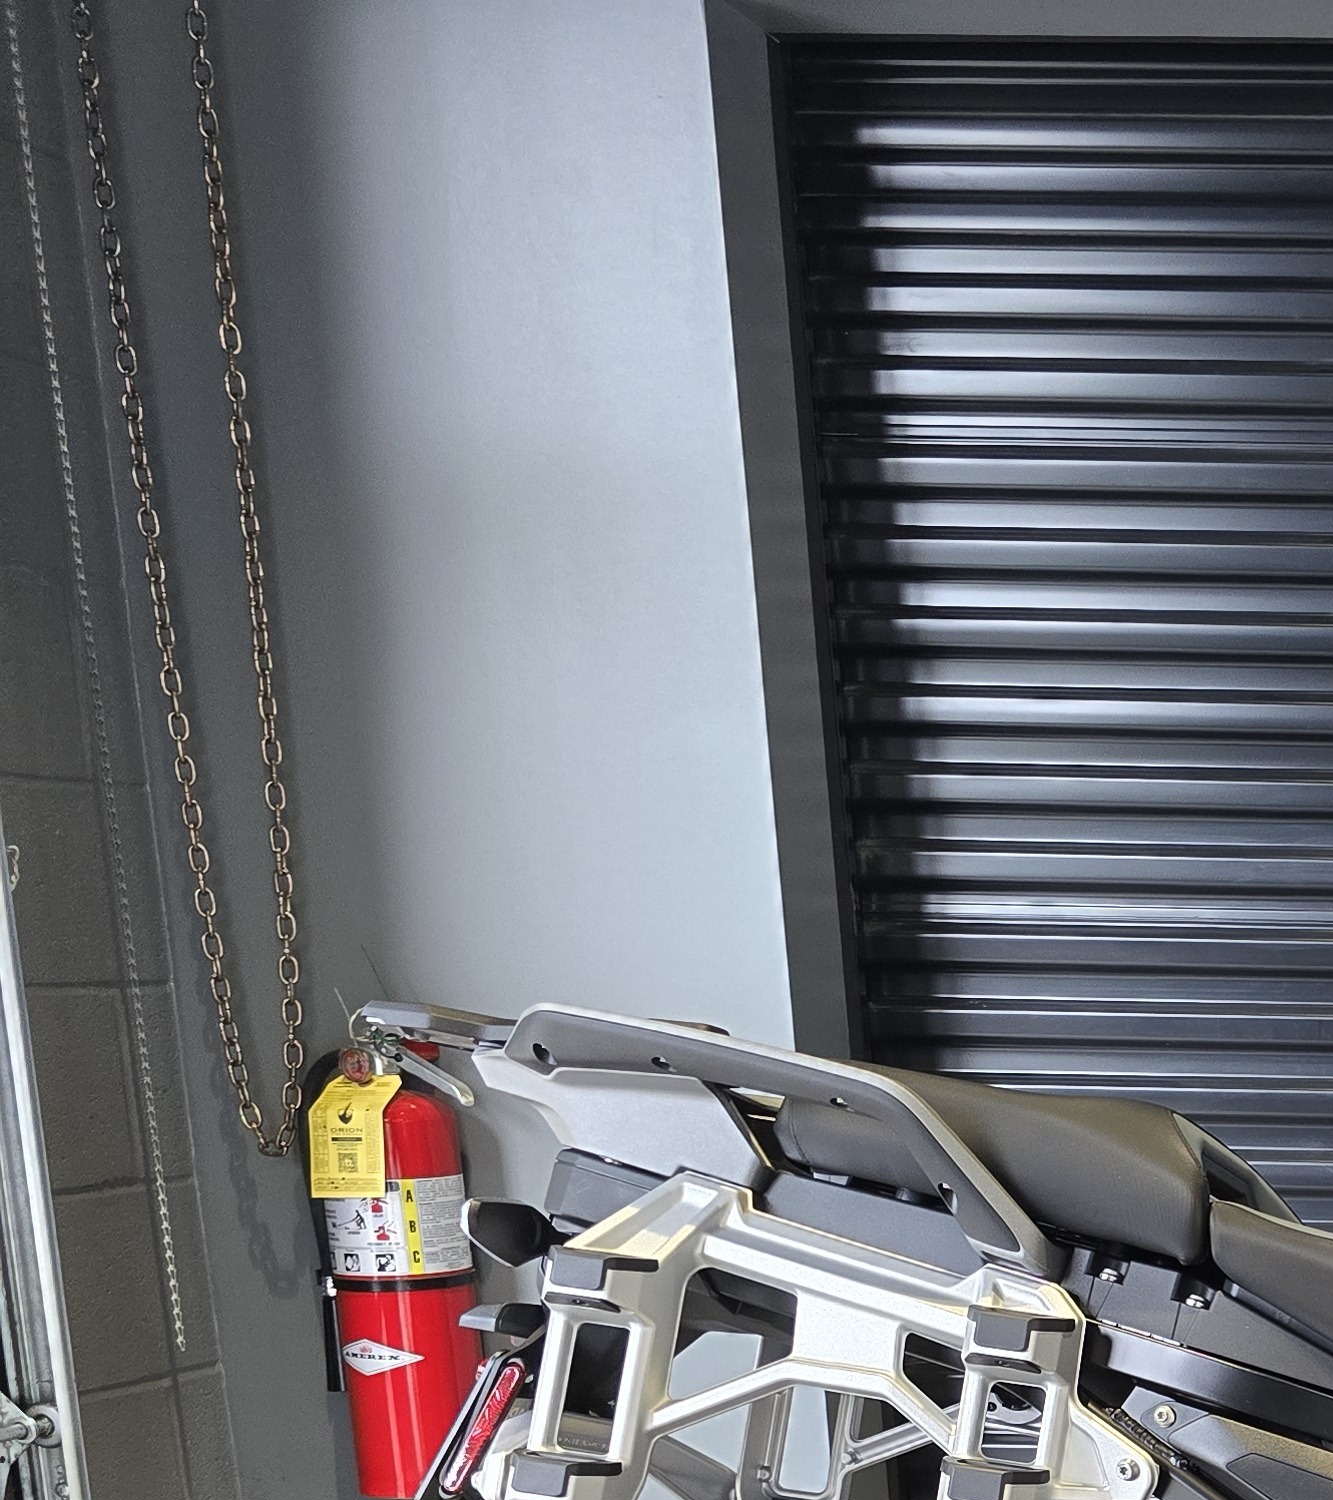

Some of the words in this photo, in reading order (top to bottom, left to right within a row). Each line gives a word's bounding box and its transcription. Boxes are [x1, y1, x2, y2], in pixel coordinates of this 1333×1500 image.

[405, 1189, 414, 1203] A
[409, 1220, 417, 1233] B
[413, 1250, 421, 1264] C
[345, 1351, 400, 1360] AMEREX
